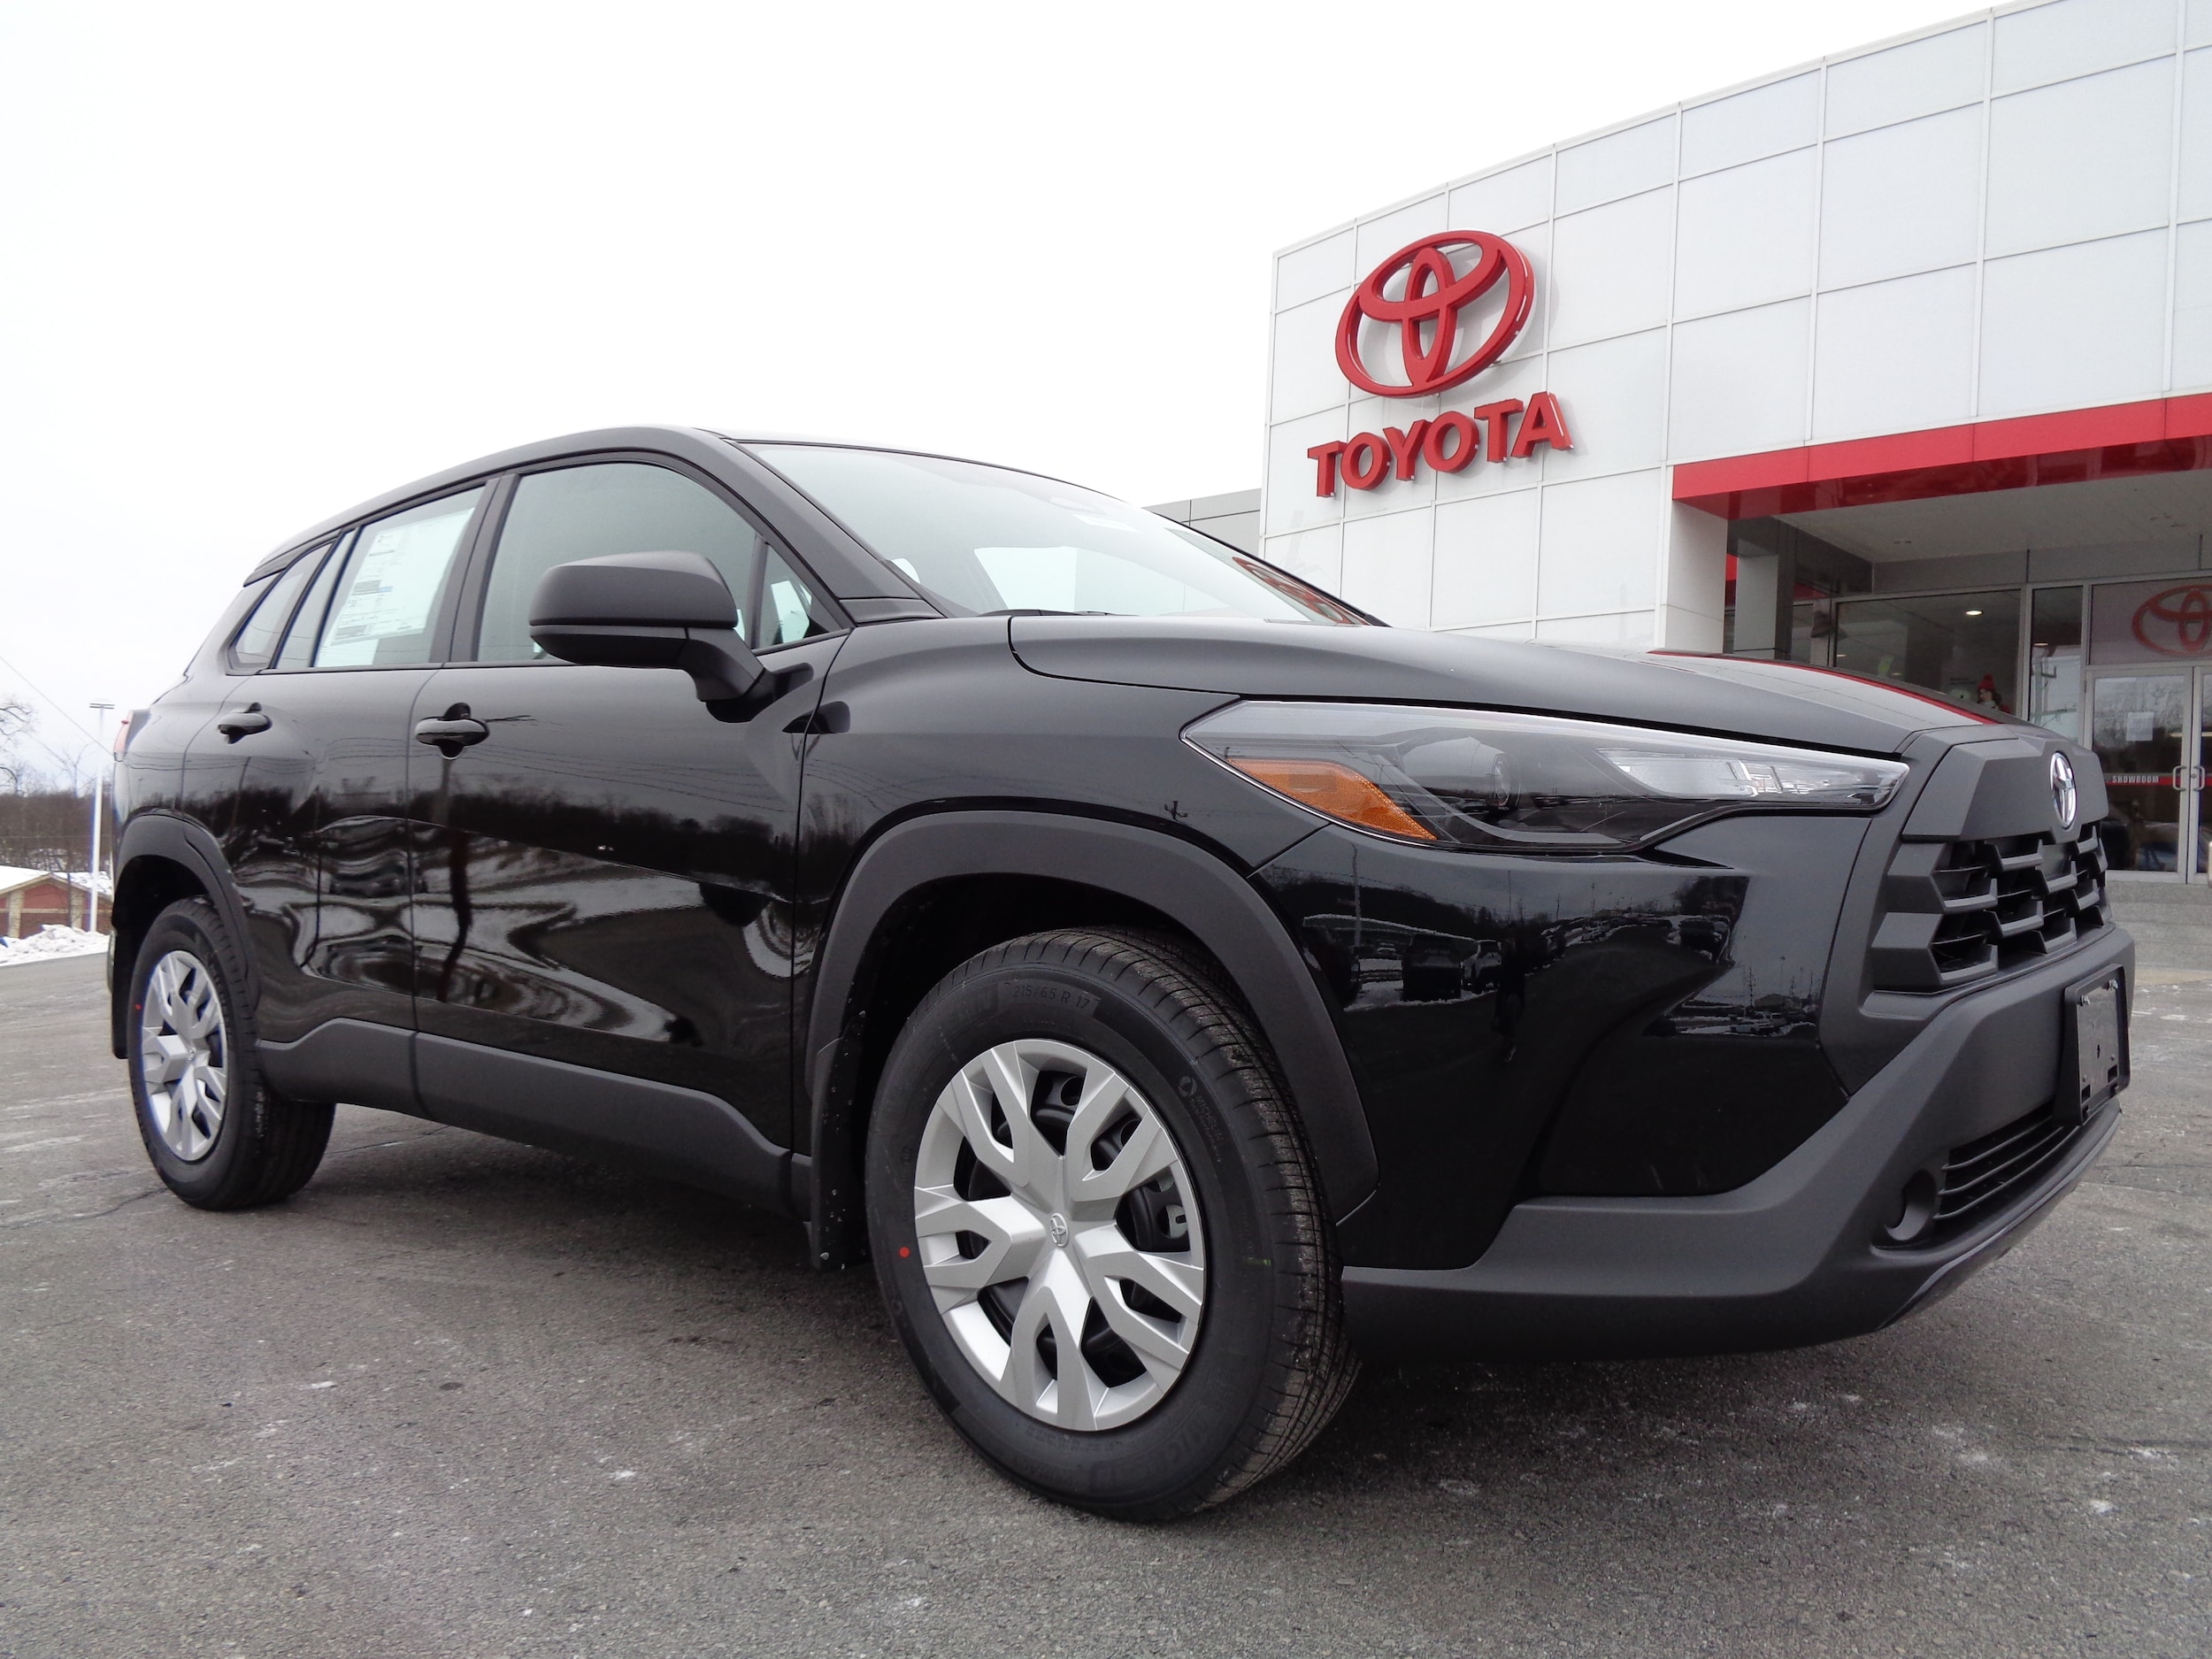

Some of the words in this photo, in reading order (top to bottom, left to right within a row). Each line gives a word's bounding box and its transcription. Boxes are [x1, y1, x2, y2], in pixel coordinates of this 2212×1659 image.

[1307, 391, 1574, 497] TOYOTA
[2111, 775, 2160, 784] SHOWROOM
[1013, 985, 1057, 1000] 215/65
[1061, 991, 1071, 1003] R
[1076, 996, 1091, 1009] 17
[1195, 1096, 1223, 1141] MICHELIN
